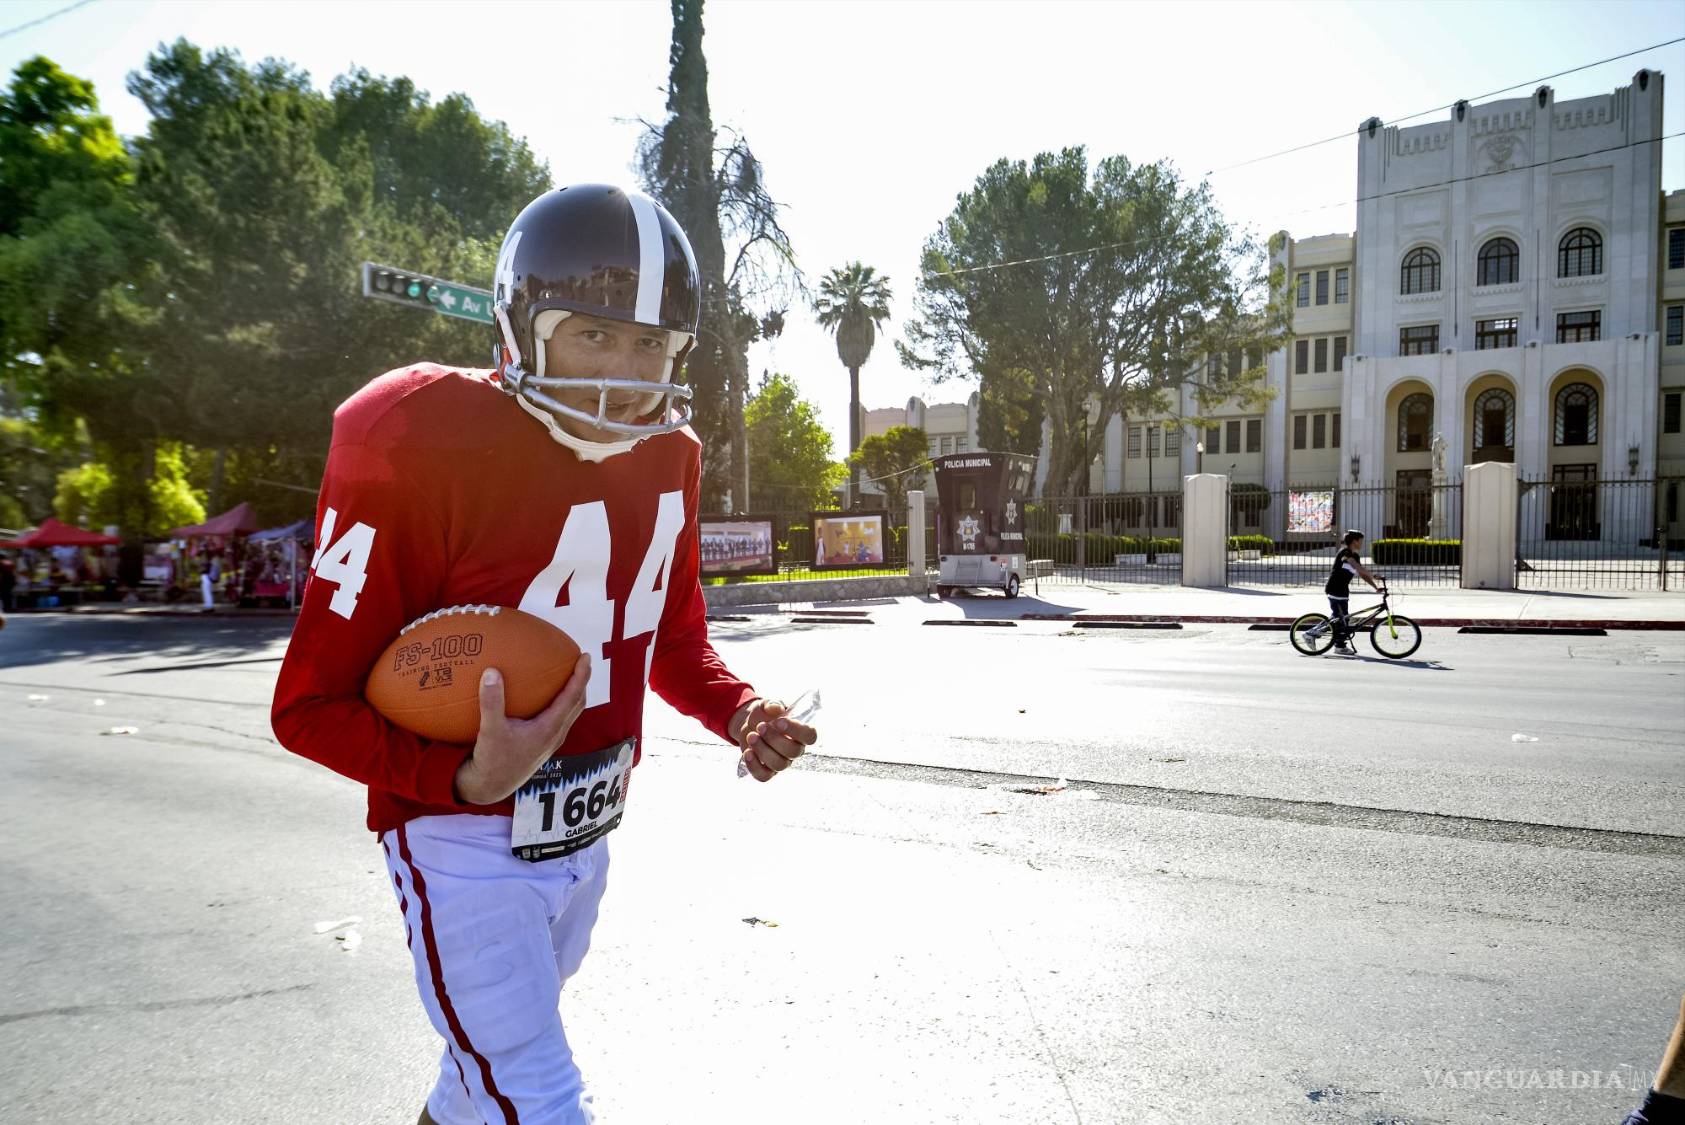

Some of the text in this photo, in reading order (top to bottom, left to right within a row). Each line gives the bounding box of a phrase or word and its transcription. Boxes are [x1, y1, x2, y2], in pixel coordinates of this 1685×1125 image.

[462, 296, 481, 314] Av
[944, 458, 992, 469] POLICIA MUNICIPAL
[517, 490, 685, 708] 44
[394, 633, 483, 672] FS-100
[434, 660, 476, 669] FOOTBALL
[538, 774, 621, 831] 1664
[565, 821, 598, 838] GABRIEL
